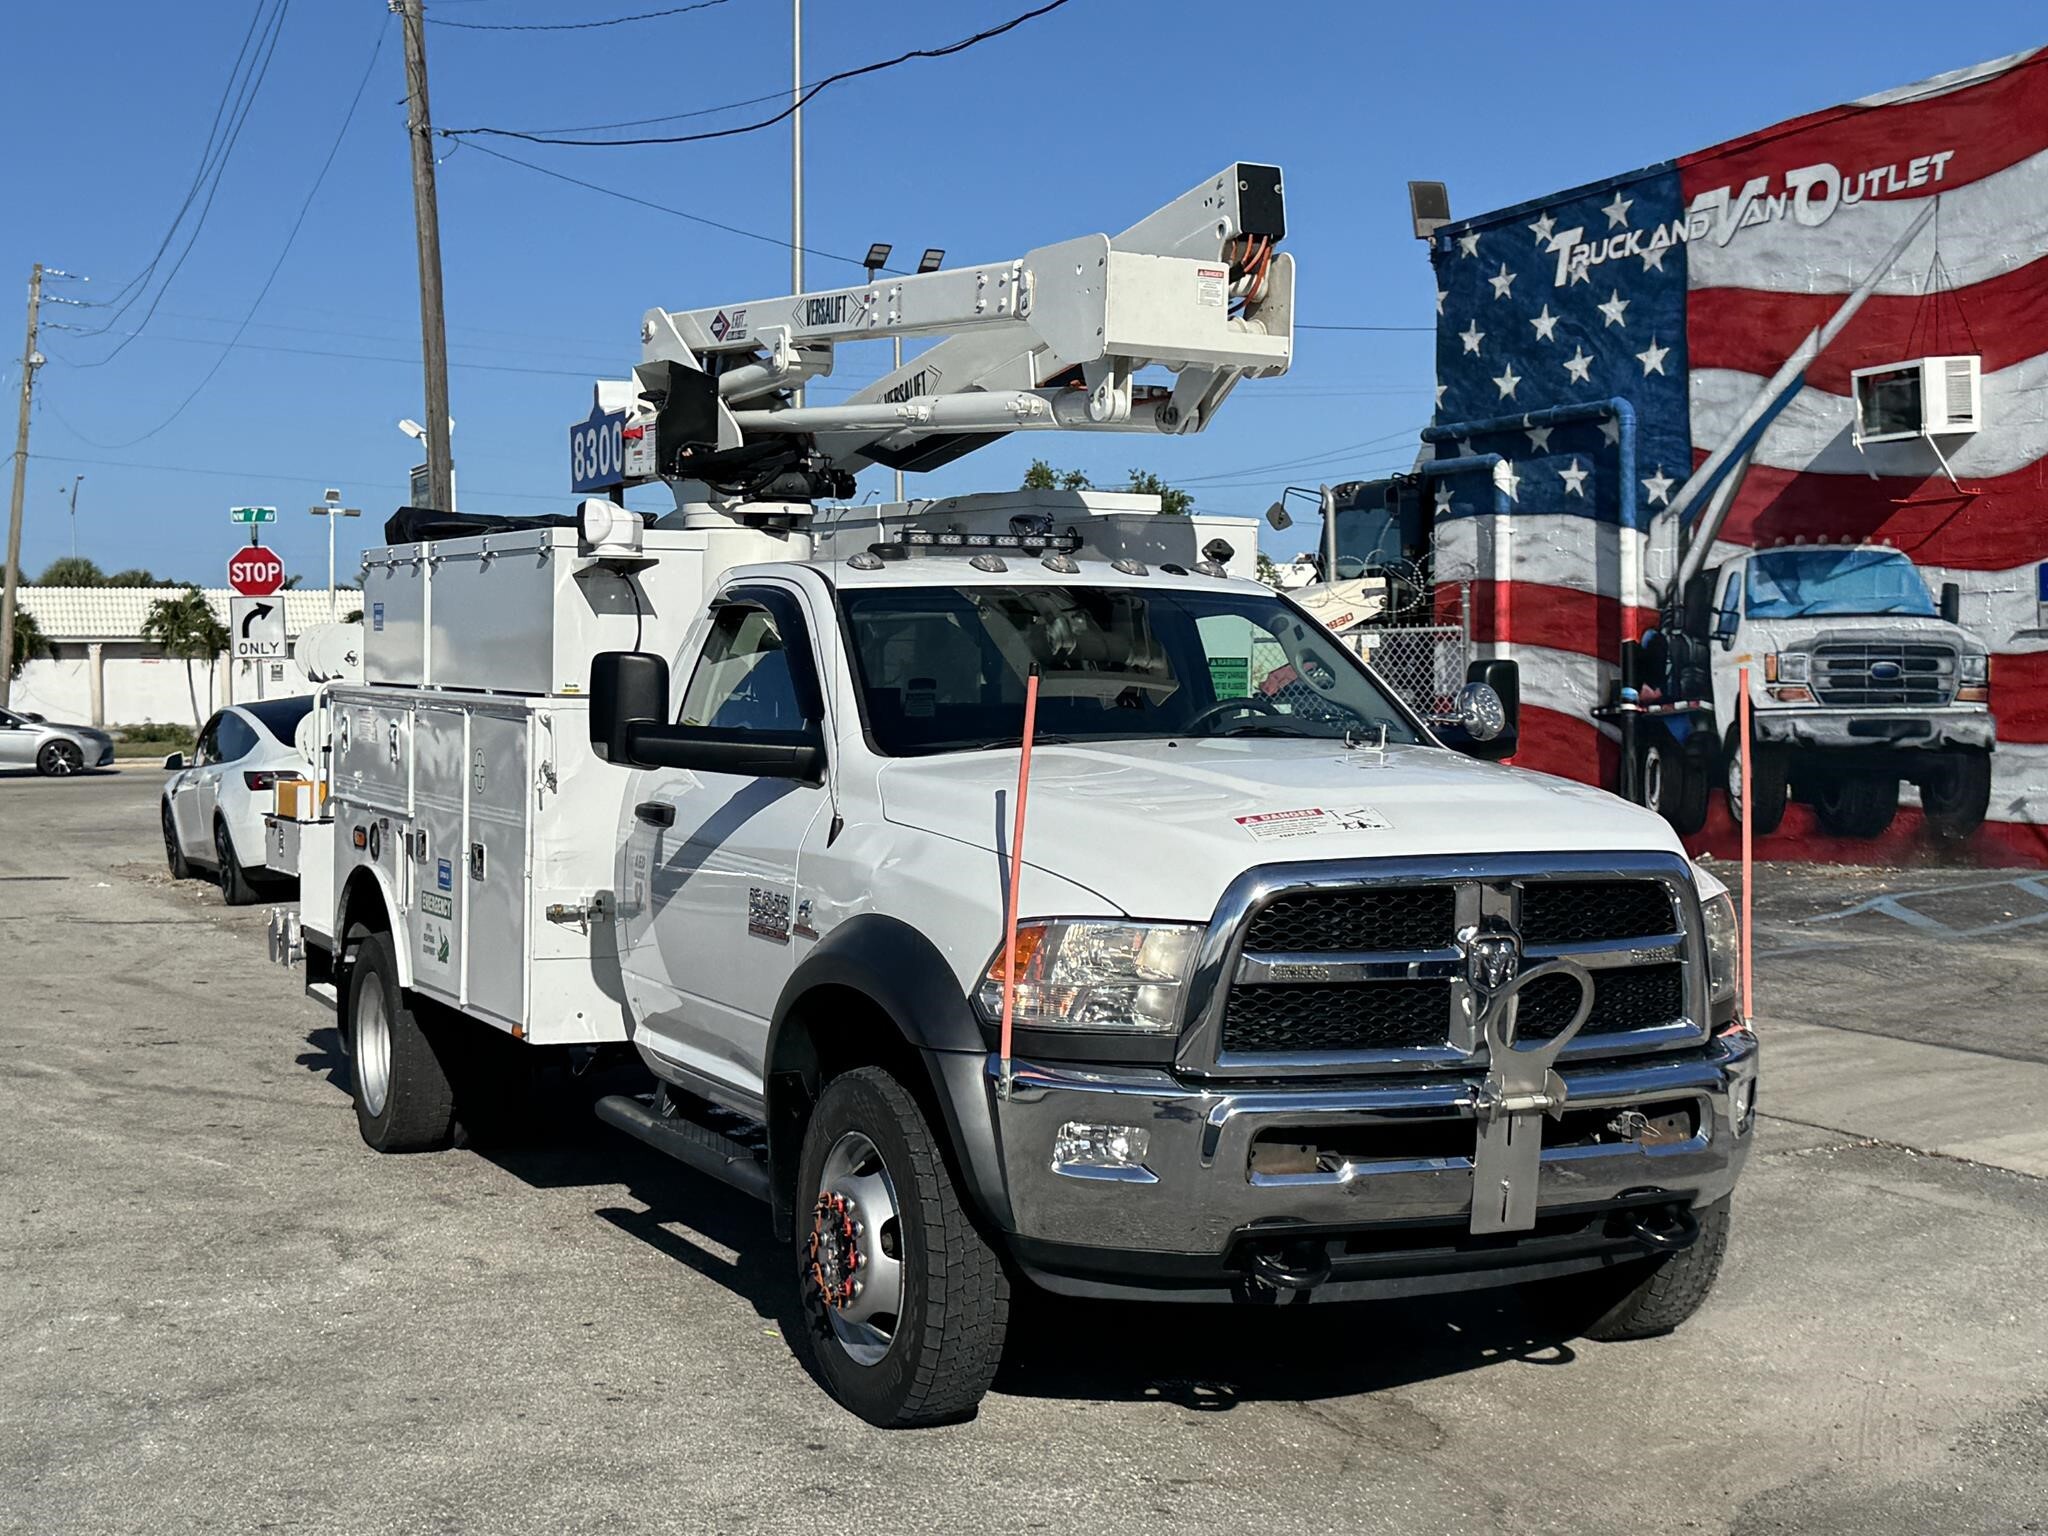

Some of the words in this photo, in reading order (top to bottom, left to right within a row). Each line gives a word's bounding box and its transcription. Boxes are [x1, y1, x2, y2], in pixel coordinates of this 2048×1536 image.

[1545, 227, 1649, 287] TRUCK
[1649, 213, 1711, 251] AND
[1690, 176, 1788, 247] VAN
[1786, 150, 1955, 227] OUTLET
[806, 295, 847, 327] VERSALIFT
[574, 421, 622, 482] 8300
[232, 512, 245, 521] NW
[250, 508, 258, 521] 7
[231, 562, 280, 583] STOP
[239, 641, 280, 655] ONLY
[1260, 809, 1318, 820] DANGER
